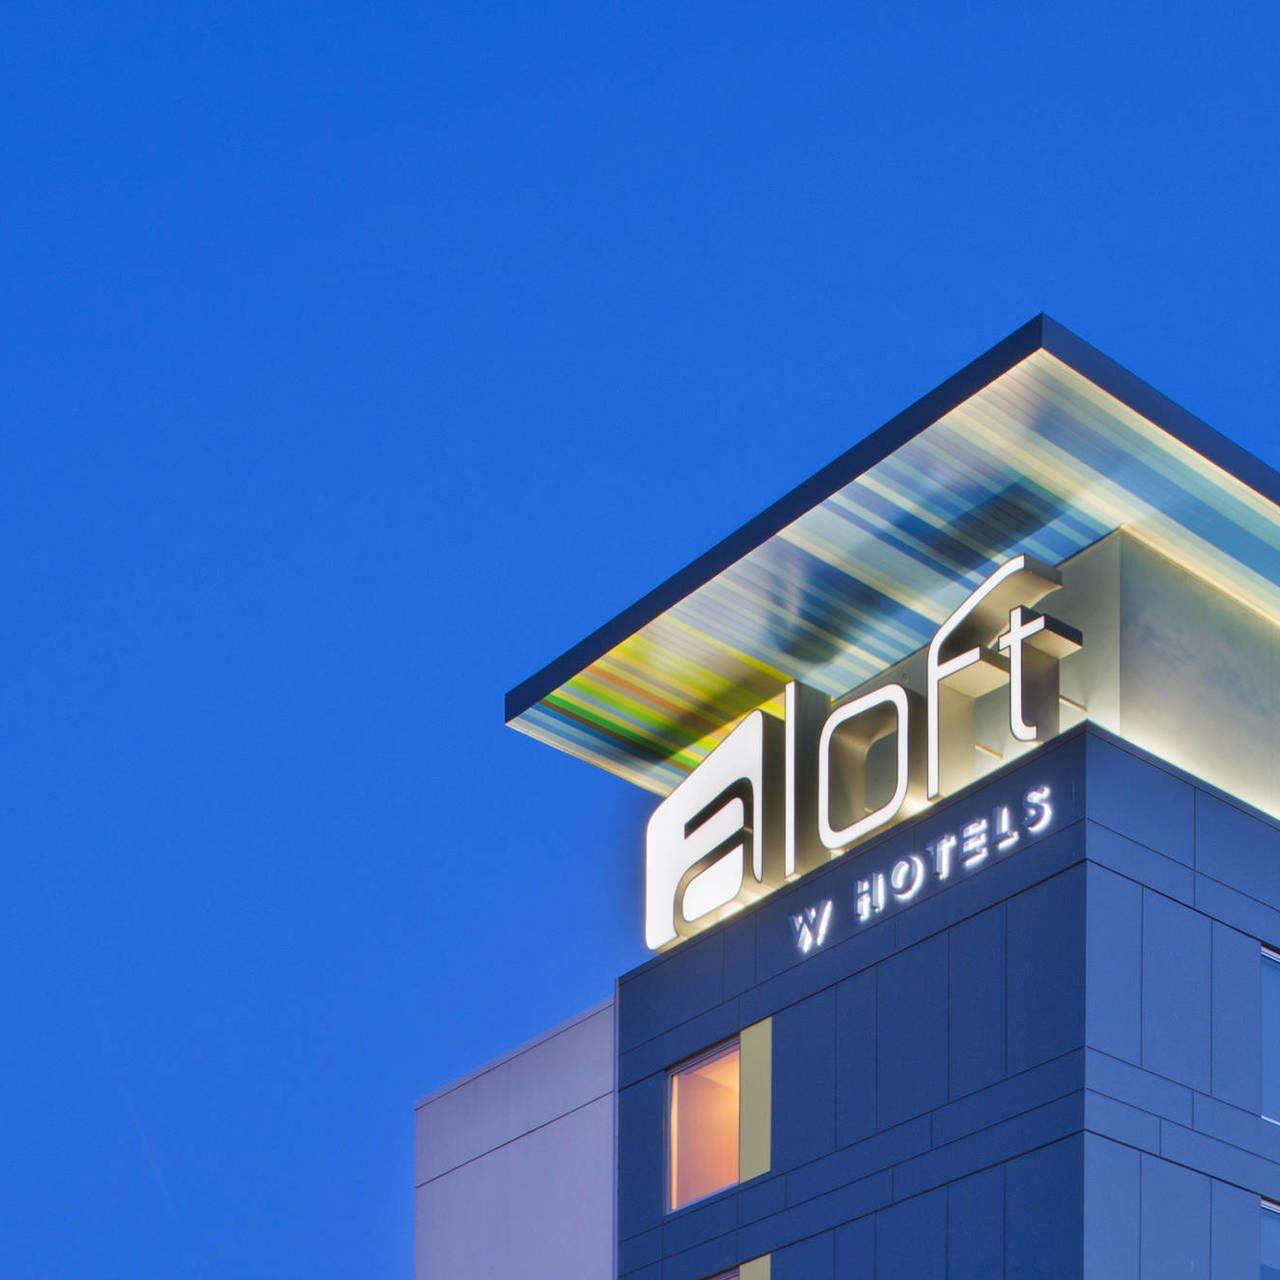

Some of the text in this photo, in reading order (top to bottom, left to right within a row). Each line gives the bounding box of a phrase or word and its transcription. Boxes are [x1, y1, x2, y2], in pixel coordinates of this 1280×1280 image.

[645, 553, 1047, 952] aloft
[791, 784, 1053, 953] W HOTELS
